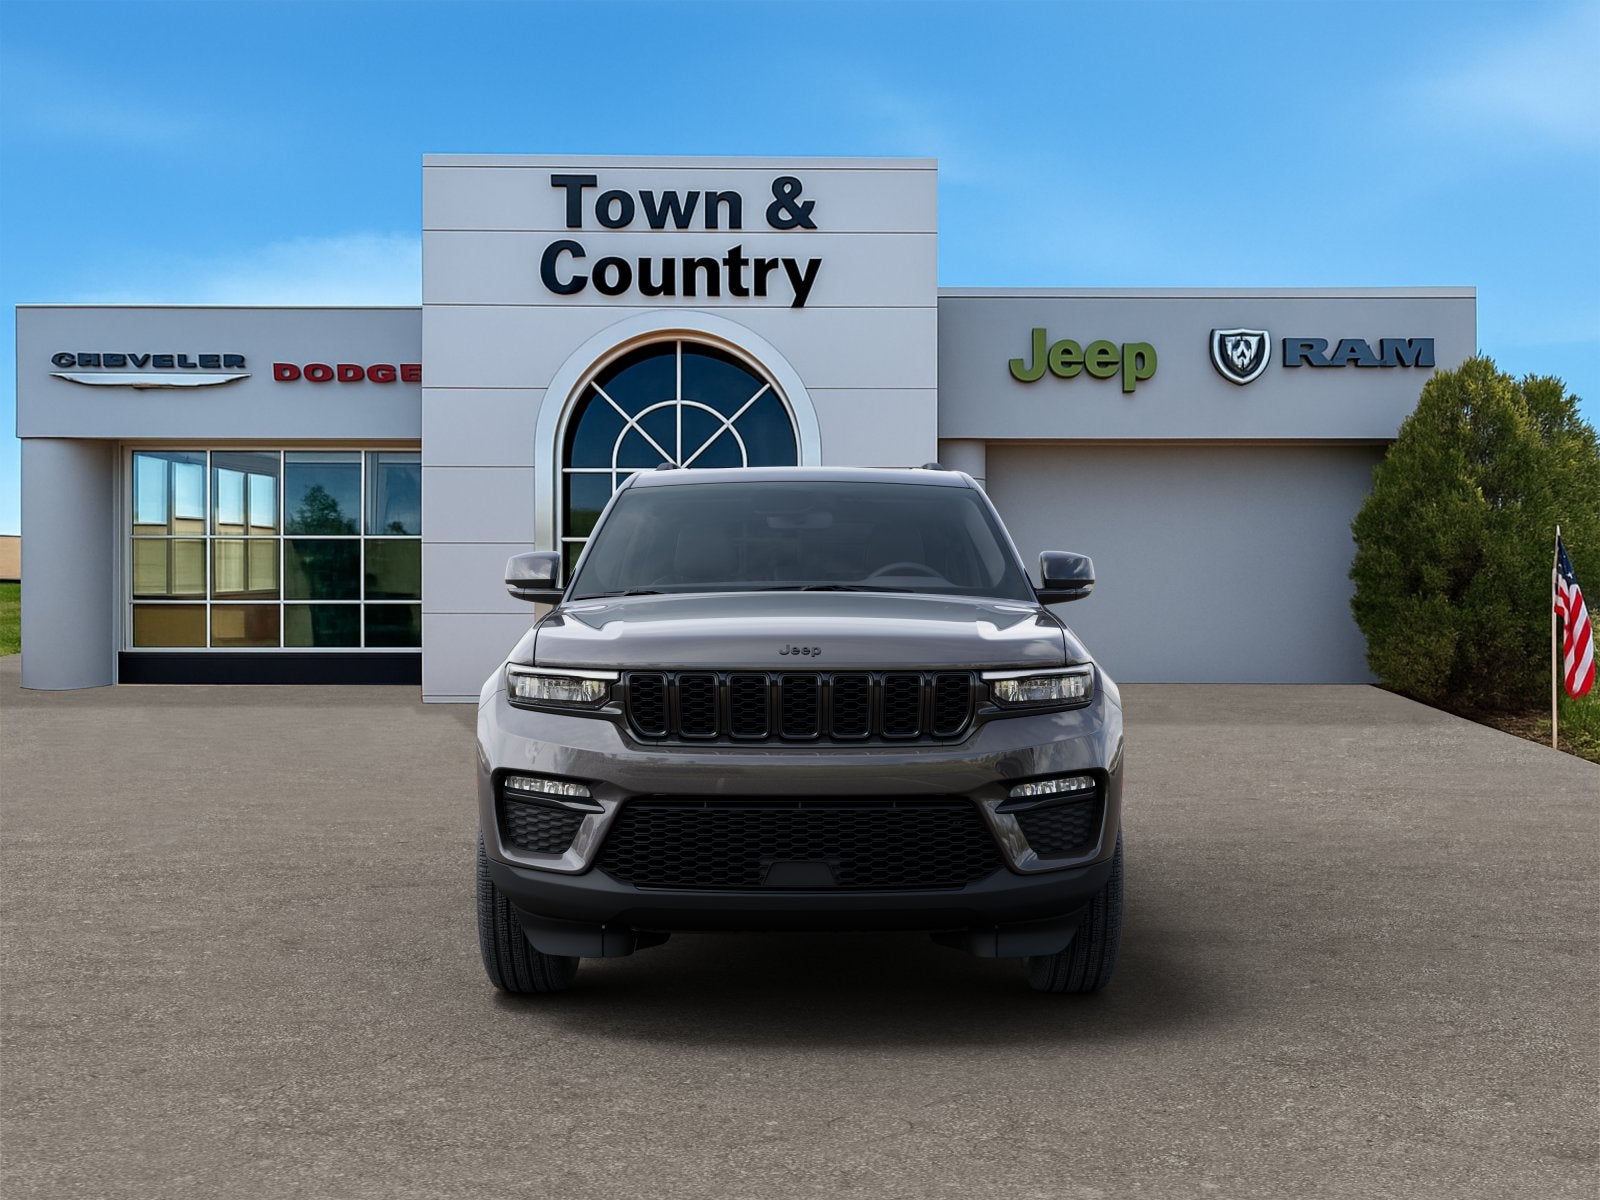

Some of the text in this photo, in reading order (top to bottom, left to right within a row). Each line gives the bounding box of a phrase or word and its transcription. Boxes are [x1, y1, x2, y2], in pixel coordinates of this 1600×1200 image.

[550, 174, 818, 230] Town &
[540, 239, 822, 308] Country
[273, 362, 422, 383] DODGE
[1009, 328, 1157, 393] Jeep
[1282, 337, 1436, 368] RAM
[779, 644, 821, 657] Jeep
